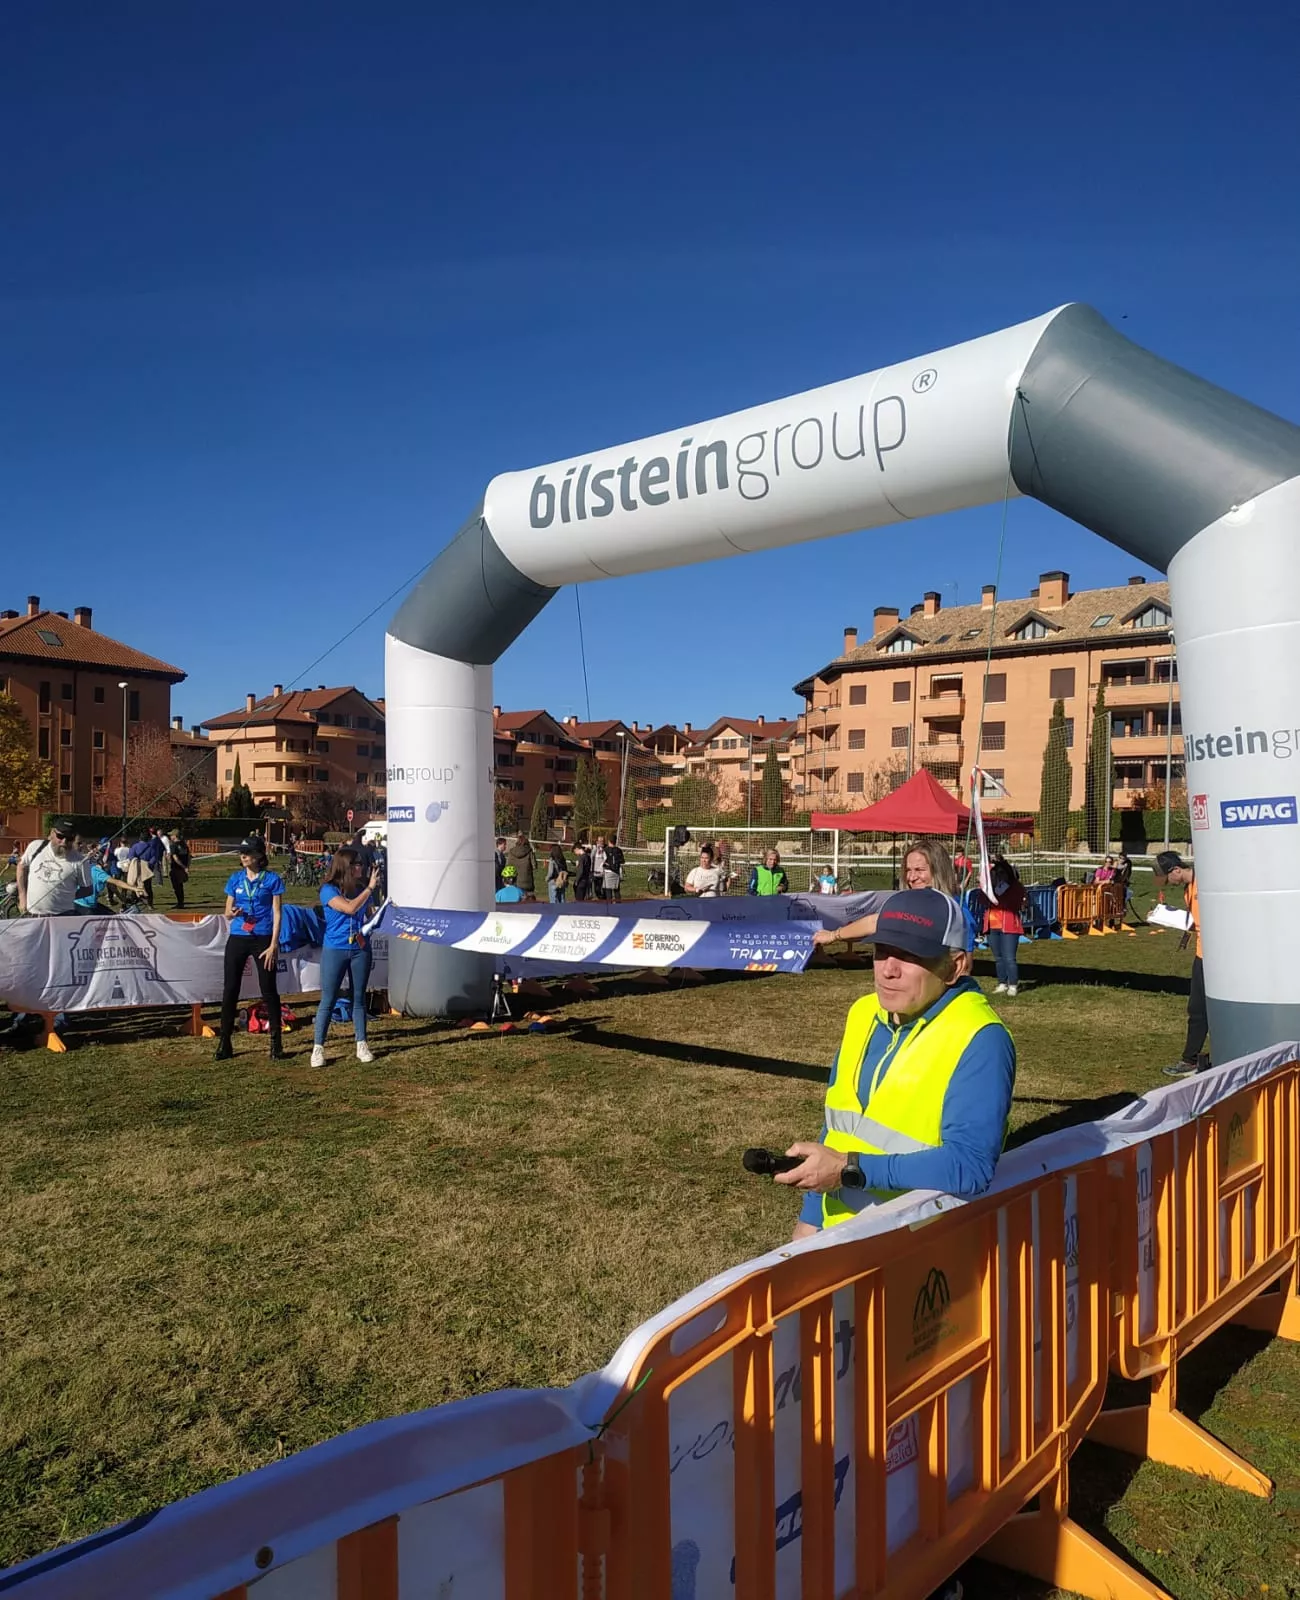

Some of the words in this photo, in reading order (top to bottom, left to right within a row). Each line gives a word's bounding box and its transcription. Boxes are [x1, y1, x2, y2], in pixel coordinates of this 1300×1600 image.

[1225, 803, 1292, 822] SWAG
[570, 919, 601, 930] JUEGOS
[553, 931, 596, 943] ESCOLARES
[644, 933, 681, 943] GOBIERNO
[538, 943, 549, 954] DE
[644, 942, 654, 950] DE
[77, 948, 94, 961] LOS
[97, 946, 151, 961] RECAMBIOS
[729, 947, 808, 961] TRIATLON
